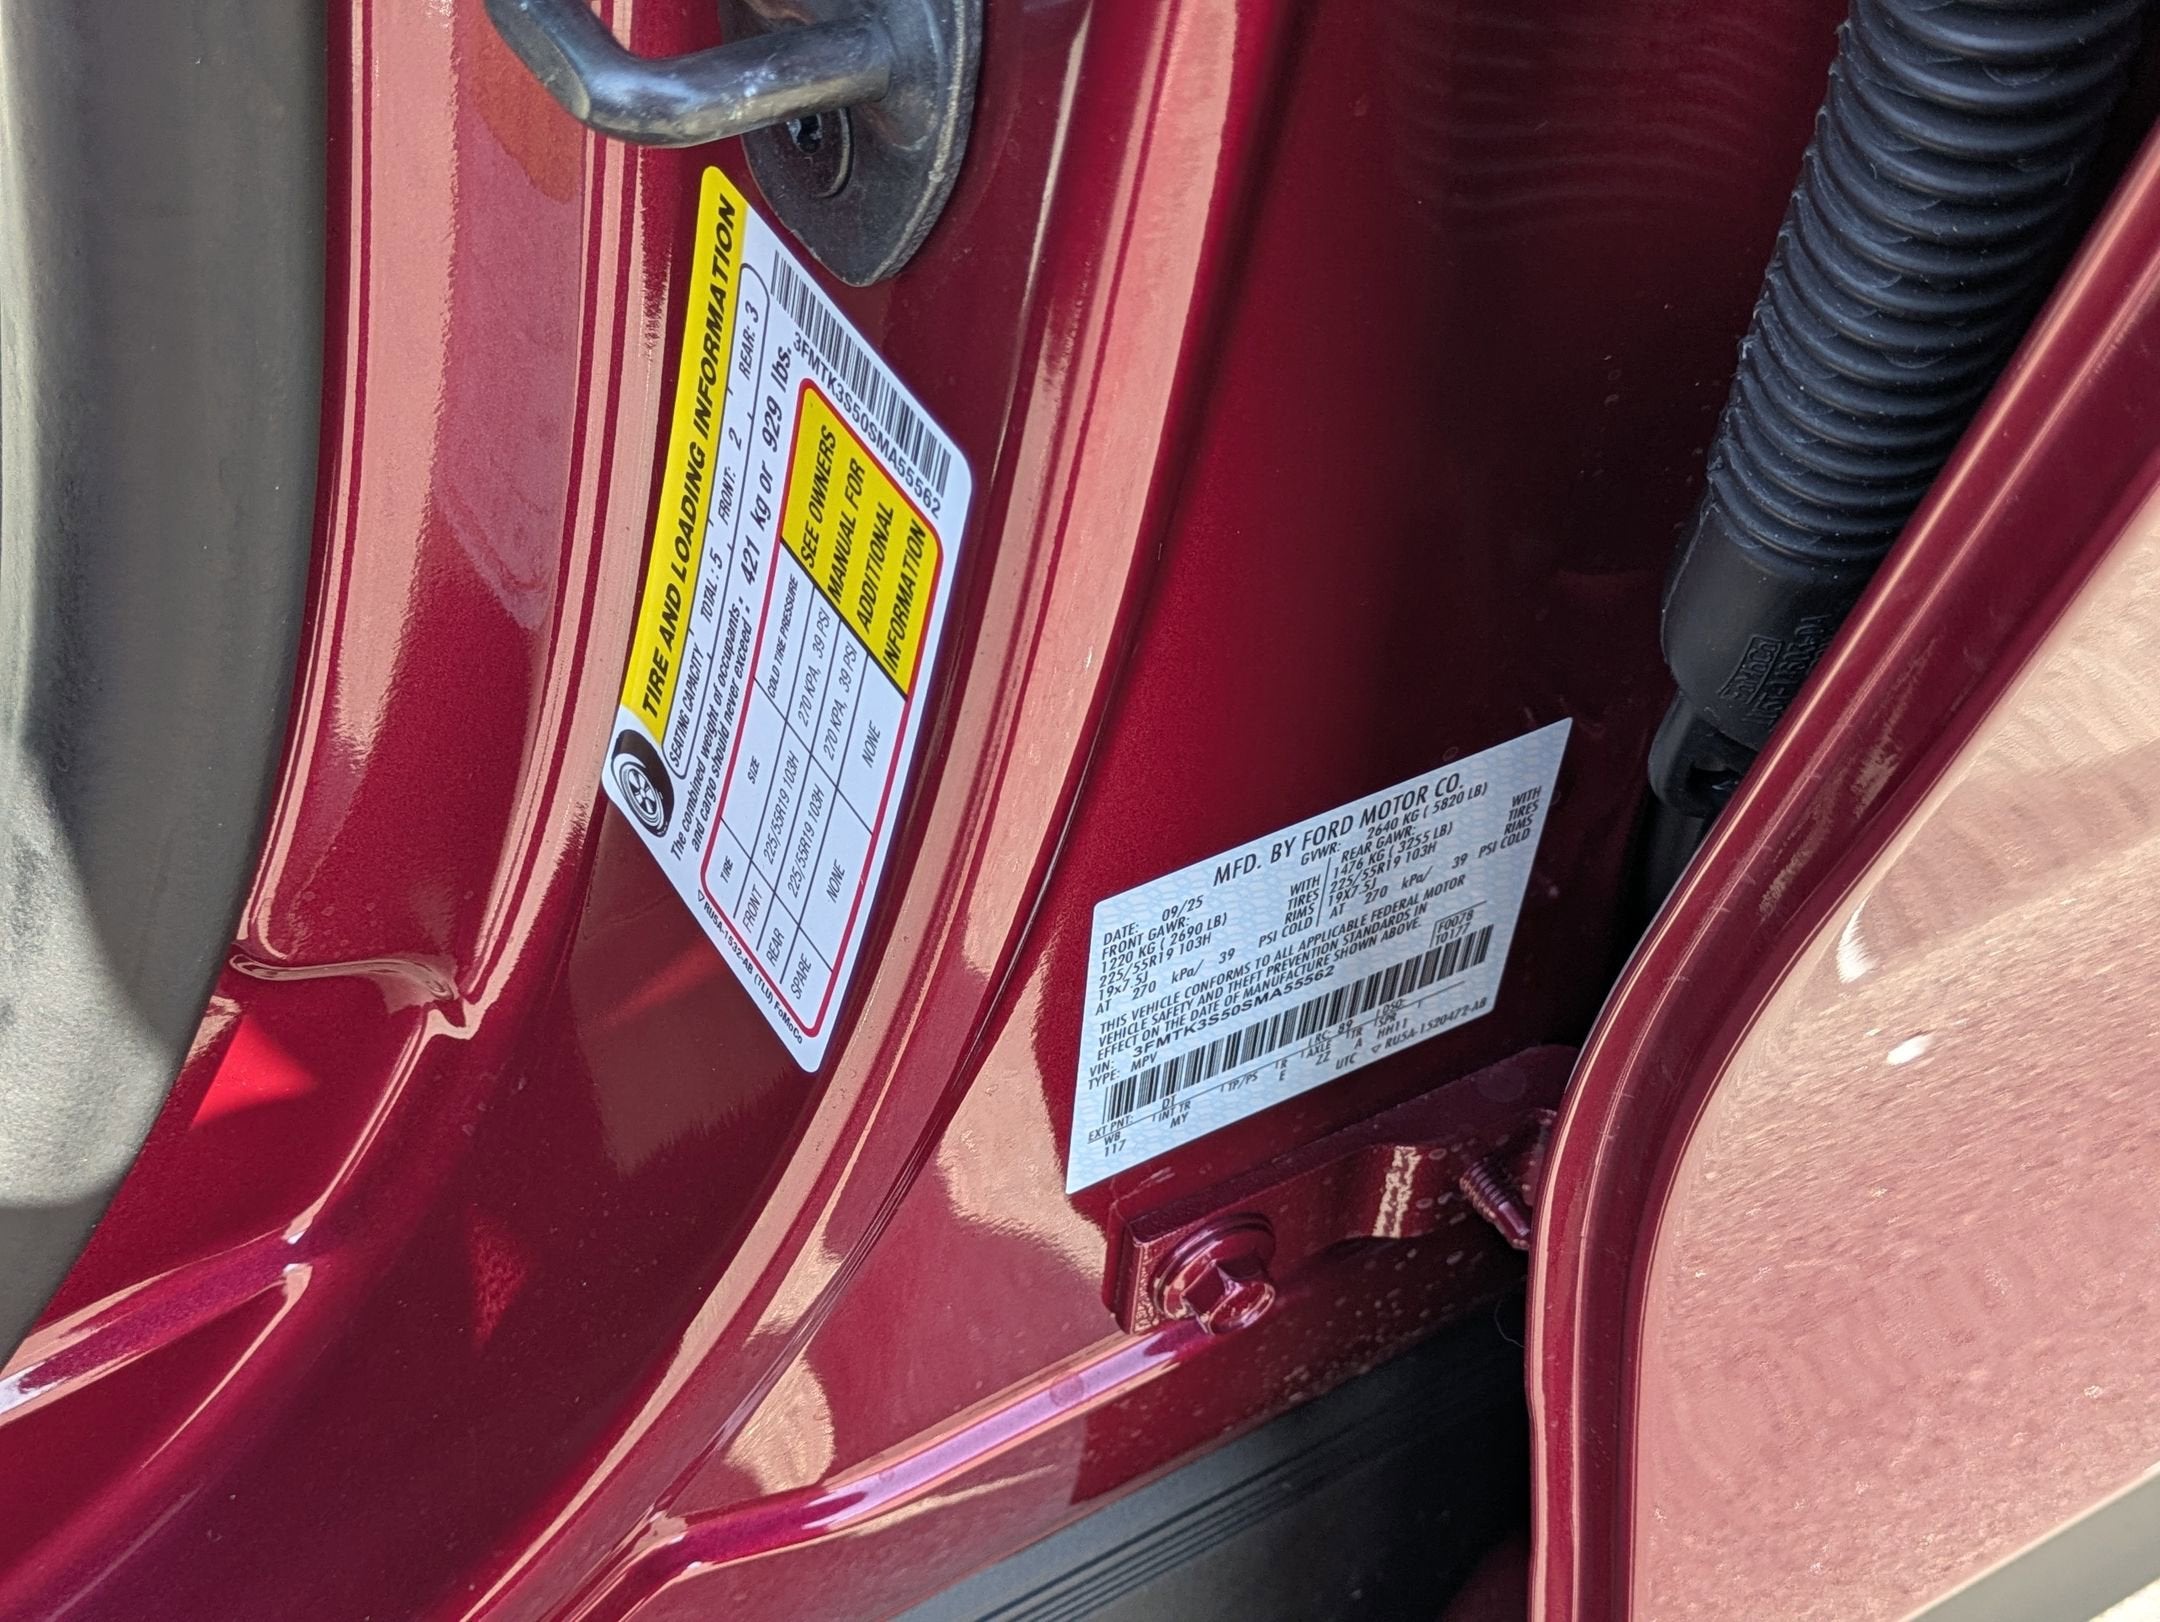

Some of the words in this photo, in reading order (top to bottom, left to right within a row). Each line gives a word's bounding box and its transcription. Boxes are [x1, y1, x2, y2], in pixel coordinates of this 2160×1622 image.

[744, 300, 759, 323] 3
[738, 325, 756, 381] REAR:
[770, 345, 792, 393] lbs.
[761, 394, 783, 453] 929
[793, 332, 941, 520] 3FMTK3S50SMA55562
[641, 646, 669, 718] TIRE
[658, 582, 682, 653] AND
[670, 440, 706, 584] LOADING
[692, 192, 736, 441] INFORMATION
[717, 466, 736, 526] FRONT:
[727, 426, 742, 451] 2
[758, 459, 773, 495] or
[808, 424, 836, 524] OWNERS
[749, 493, 772, 532] kg
[826, 510, 857, 605] MANUAL
[844, 457, 865, 511] FOR
[708, 546, 723, 570] 5
[740, 534, 760, 585] 421
[800, 519, 820, 569] SEE
[856, 501, 894, 634] ADDITIONAL
[778, 573, 799, 640] PRESSURE
[882, 518, 926, 674] INFORMATION
[716, 602, 745, 688] occupants
[811, 633, 825, 659] 39
[815, 606, 831, 638] PSI
[773, 635, 787, 666] TIRE
[842, 640, 858, 672] PSI
[712, 682, 724, 707] of
[766, 663, 780, 699] COLD
[803, 664, 821, 699] KPA,
[837, 667, 852, 694] 39
[668, 708, 690, 768] SEATING
[681, 642, 704, 713] CAPACITY
[797, 693, 812, 728] 270
[829, 698, 848, 733] KPA,
[691, 816, 705, 853] and
[699, 776, 717, 822] cargo
[710, 720, 730, 779] should
[723, 676, 740, 726] never
[733, 615, 752, 679] exceed
[699, 703, 719, 760] weight
[822, 727, 838, 761] 270
[861, 719, 881, 769] NONE
[681, 755, 706, 833] combined
[746, 755, 760, 785] SIZE
[762, 787, 790, 865] 225/55R19
[782, 749, 799, 790] 103H
[1507, 798, 1540, 822] TIRES
[1511, 785, 1542, 808] WITH
[669, 830, 687, 861] The
[786, 820, 815, 899] 225/55R19
[807, 782, 825, 824] 103H
[1212, 852, 1262, 887] MFD.
[1269, 835, 1297, 864] BY
[1301, 814, 1354, 851] FORD
[1358, 784, 1429, 829] MOTOR
[1434, 772, 1464, 798] CO.
[1300, 840, 1342, 866] GVWR:
[1365, 816, 1399, 841] 2640
[1401, 808, 1420, 826] KG
[1431, 790, 1465, 814] 5820
[1466, 781, 1488, 801] LB)
[1340, 840, 1373, 864] REAR
[1375, 824, 1416, 850] GAWR:
[1503, 813, 1534, 836] RIMS
[719, 855, 734, 883] TIRE
[1328, 901, 1346, 920] AT
[1363, 884, 1389, 905] 270
[1400, 865, 1433, 890] kPa/
[1451, 852, 1469, 869] 39
[1477, 840, 1498, 859] PSI
[1499, 826, 1531, 849] COLD
[1329, 854, 1402, 894] 225/55R19
[1405, 840, 1438, 864] 103H
[1333, 856, 1364, 880] 1476
[1367, 847, 1386, 866] KG
[1396, 829, 1431, 854] 3255
[1432, 820, 1453, 840] LB)
[825, 858, 846, 903] NONE
[1287, 887, 1320, 911] TIRES
[1289, 873, 1321, 897] WITH
[741, 883, 762, 934] FRONT
[1102, 921, 1139, 946] DATE:
[1161, 894, 1204, 922] 09/25
[1283, 901, 1315, 925] RIMS
[765, 927, 785, 967] REAR
[1098, 946, 1175, 989] 225/55R19
[1179, 931, 1212, 955] 103H
[1099, 1012, 1127, 1035] THIS
[1131, 990, 1180, 1021] VEHICLE
[1183, 961, 1251, 999] CONFORMS
[1255, 953, 1271, 970] TO
[1273, 944, 1293, 963] ALL
[1297, 912, 1368, 953] APPLICABLE
[1369, 892, 1419, 923] FEDERAL
[1422, 873, 1466, 901] MOTOR
[1101, 932, 1144, 961] FRONT
[1147, 915, 1190, 941] GAWR:
[1101, 949, 1134, 974] 1220
[1137, 940, 1156, 959] KG
[1169, 921, 1204, 947] 2690
[1206, 911, 1228, 931] LB)
[789, 952, 812, 1000] SPARE
[1094, 997, 1112, 1016] AT
[1131, 979, 1157, 1001] 270
[1170, 958, 1204, 984] kPa/
[1217, 947, 1236, 965] 39
[1257, 929, 1278, 949] PSI
[1280, 915, 1313, 938] COLD
[1096, 1033, 1139, 1061] EFFECT
[1141, 1024, 1160, 1042] ON
[1164, 1013, 1186, 1033] THE
[1189, 998, 1220, 1022] DATE
[1223, 990, 1240, 1007] OF
[1242, 952, 1332, 1000] MANUFACTURE
[1332, 933, 1378, 962] SHOWN
[1379, 916, 1421, 943] ABOVE.
[1098, 1016, 1148, 1048] VEHICLE
[1151, 997, 1195, 1026] SAFETY
[1196, 985, 1224, 1007] AND
[1227, 968, 1263, 994] THEFT
[1265, 937, 1339, 978] PREVENTION
[1342, 907, 1411, 946] STANDARDS
[1413, 901, 1428, 917] IN
[774, 1000, 803, 1044] FoMoCo
[1089, 1059, 1114, 1078] VIN:
[1132, 963, 1336, 1058] 3FMTK3S50SMA55562
[1088, 1068, 1120, 1090] TYPE:
[1129, 1050, 1158, 1073] MPV
[1335, 1051, 1357, 1070] UTC
[1087, 1124, 1108, 1142] EXT
[1169, 1111, 1189, 1129] MY
[1104, 1138, 1127, 1158] 117
